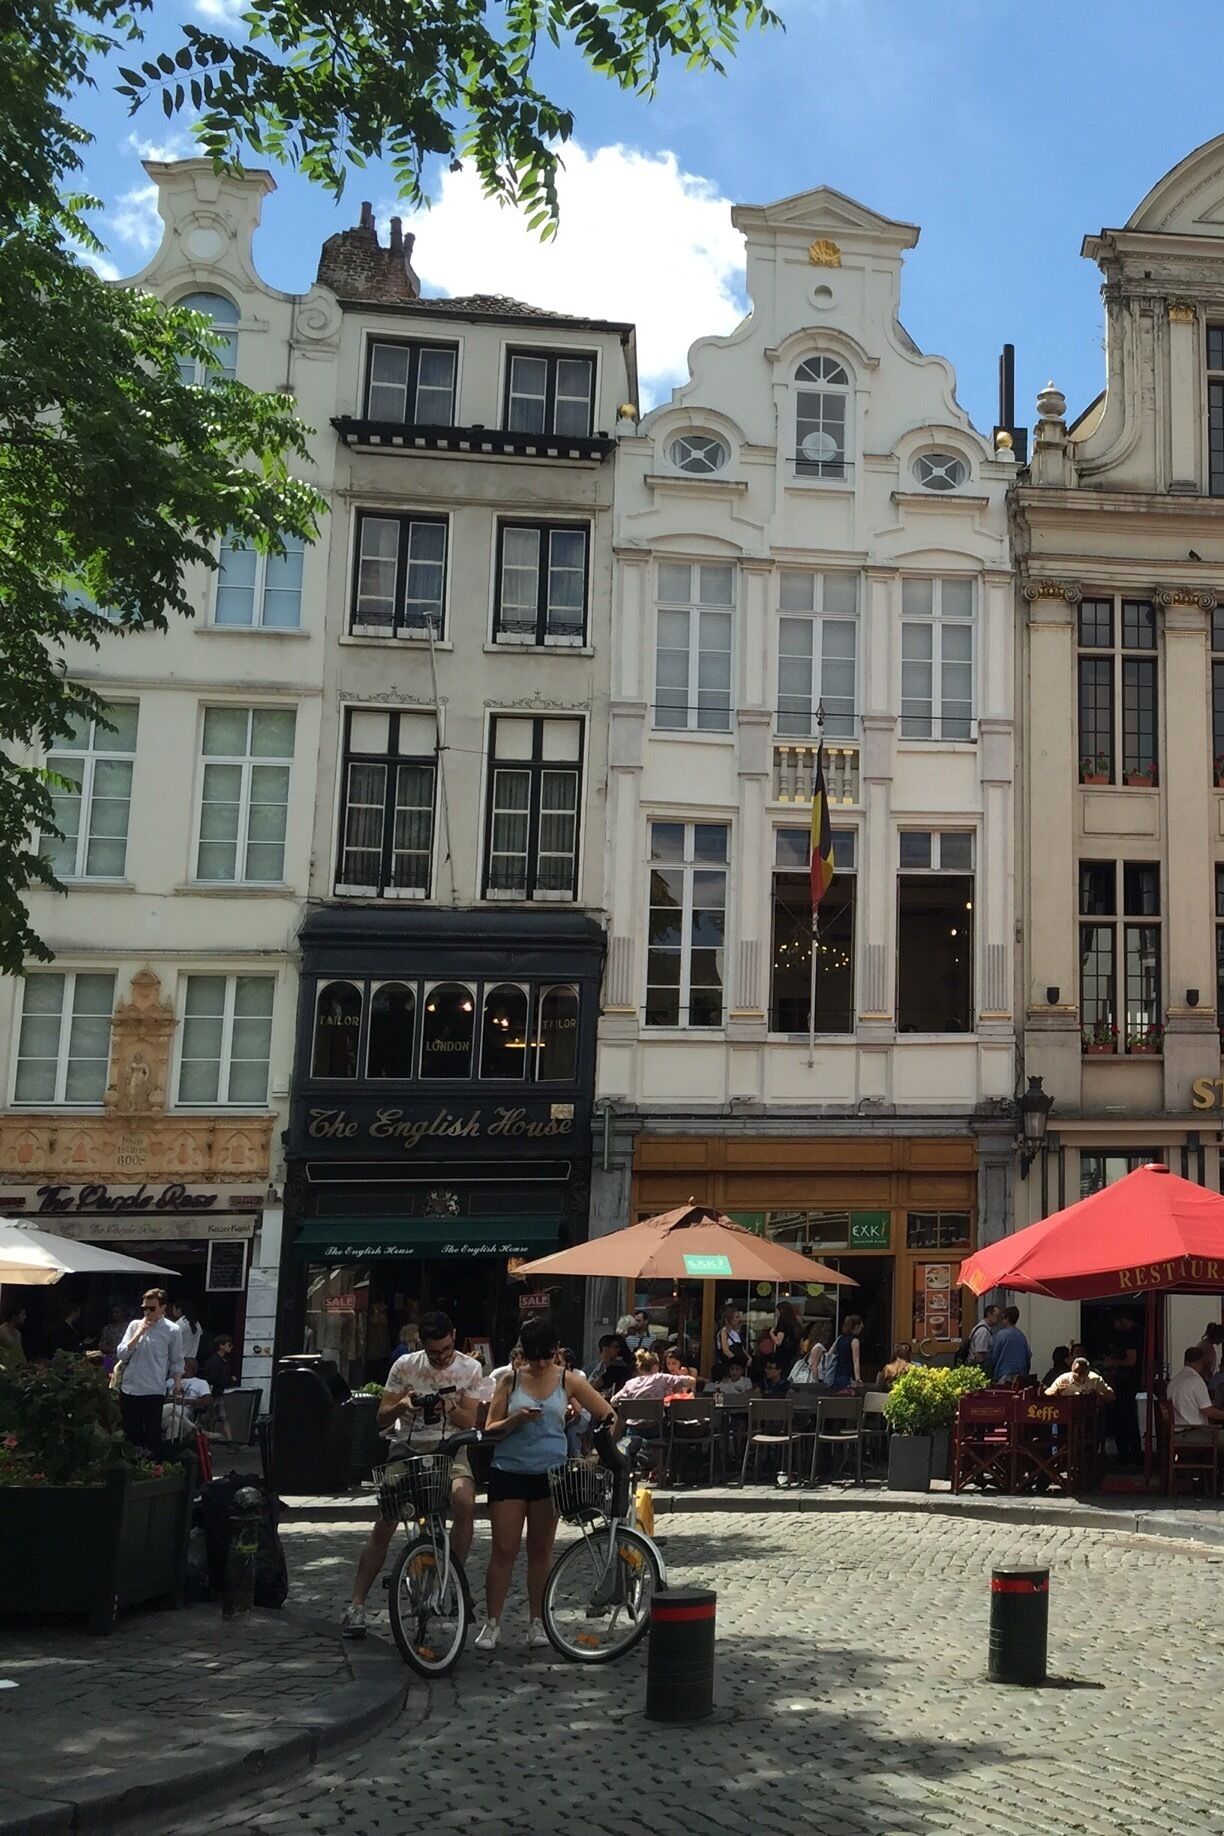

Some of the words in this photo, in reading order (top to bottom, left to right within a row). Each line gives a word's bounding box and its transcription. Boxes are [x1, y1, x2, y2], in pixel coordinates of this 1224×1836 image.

[319, 1014, 360, 1026] TAILOR
[425, 1040, 470, 1052] LONDON
[309, 1108, 358, 1138] The
[368, 1108, 481, 1149] English
[487, 1107, 573, 1138] House
[36, 1184, 76, 1212] The
[76, 1183, 154, 1213] Purple
[156, 1183, 218, 1210] Rose
[325, 1246, 343, 1256] The
[344, 1245, 382, 1258] English
[382, 1246, 414, 1255] House
[441, 1244, 459, 1254] The
[460, 1244, 498, 1257] English
[498, 1243, 529, 1253] House
[324, 1297, 354, 1307] SALE
[521, 1296, 549, 1306] SALE
[1026, 1403, 1060, 1421] Leffe
